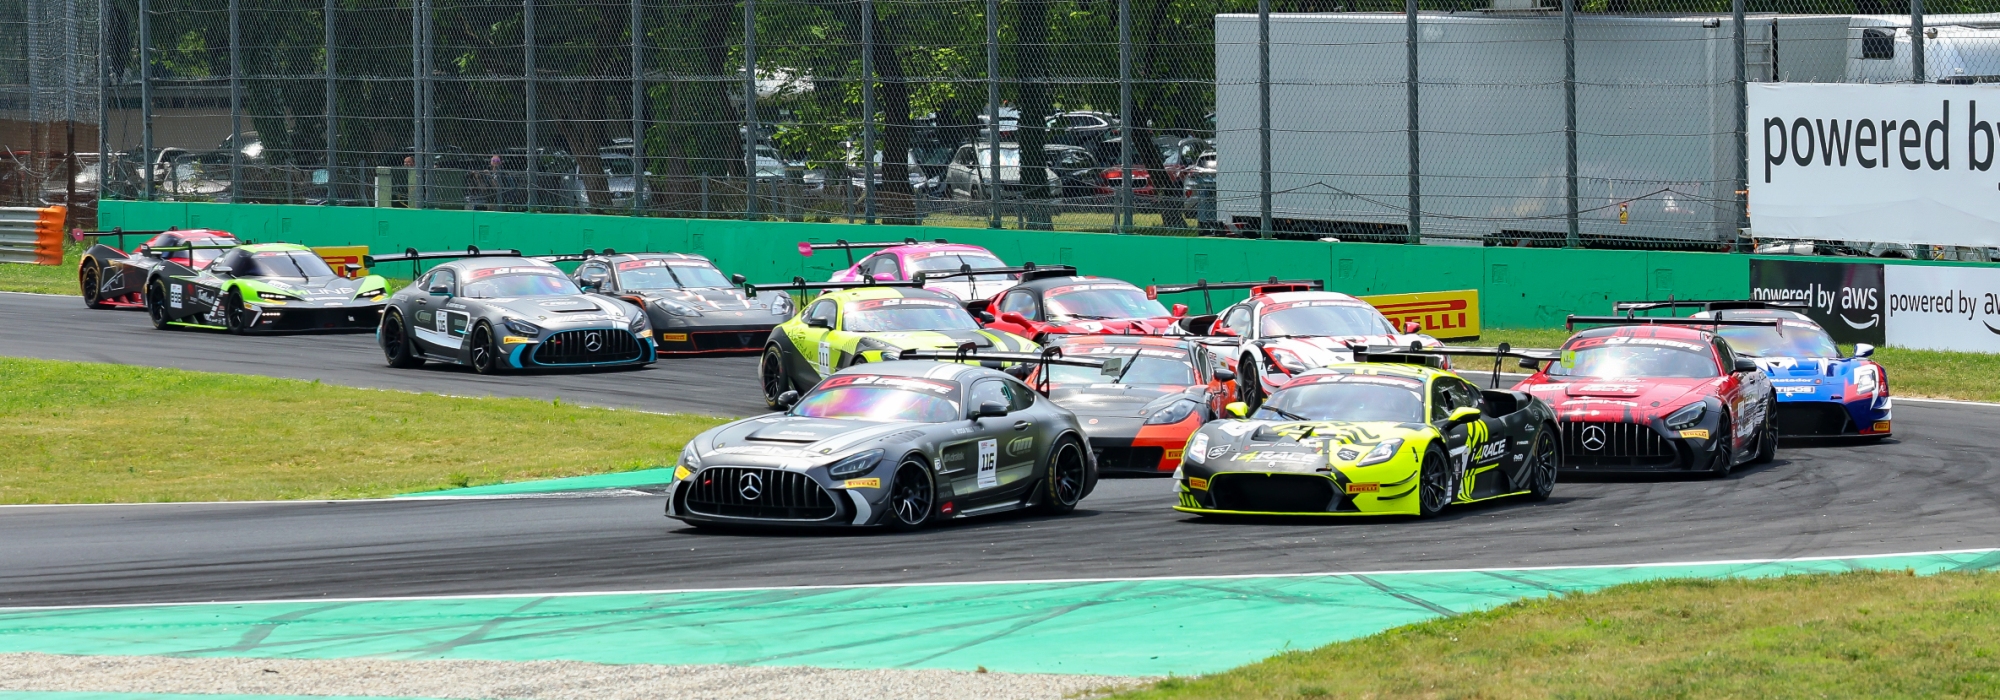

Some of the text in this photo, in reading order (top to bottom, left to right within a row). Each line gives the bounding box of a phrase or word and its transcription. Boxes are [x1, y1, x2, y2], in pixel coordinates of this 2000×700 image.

[1764, 100, 2000, 191] powered b
[1817, 283, 1836, 315] by
[1841, 286, 1878, 311] aws
[1889, 289, 1953, 317] powered
[1959, 289, 1977, 321] by
[1629, 337, 1705, 353] EUROPE
[819, 352, 829, 367] 111
[981, 453, 994, 472] 116
[847, 479, 878, 488] PIRELLI
[1349, 483, 1377, 492] PIRELLI
